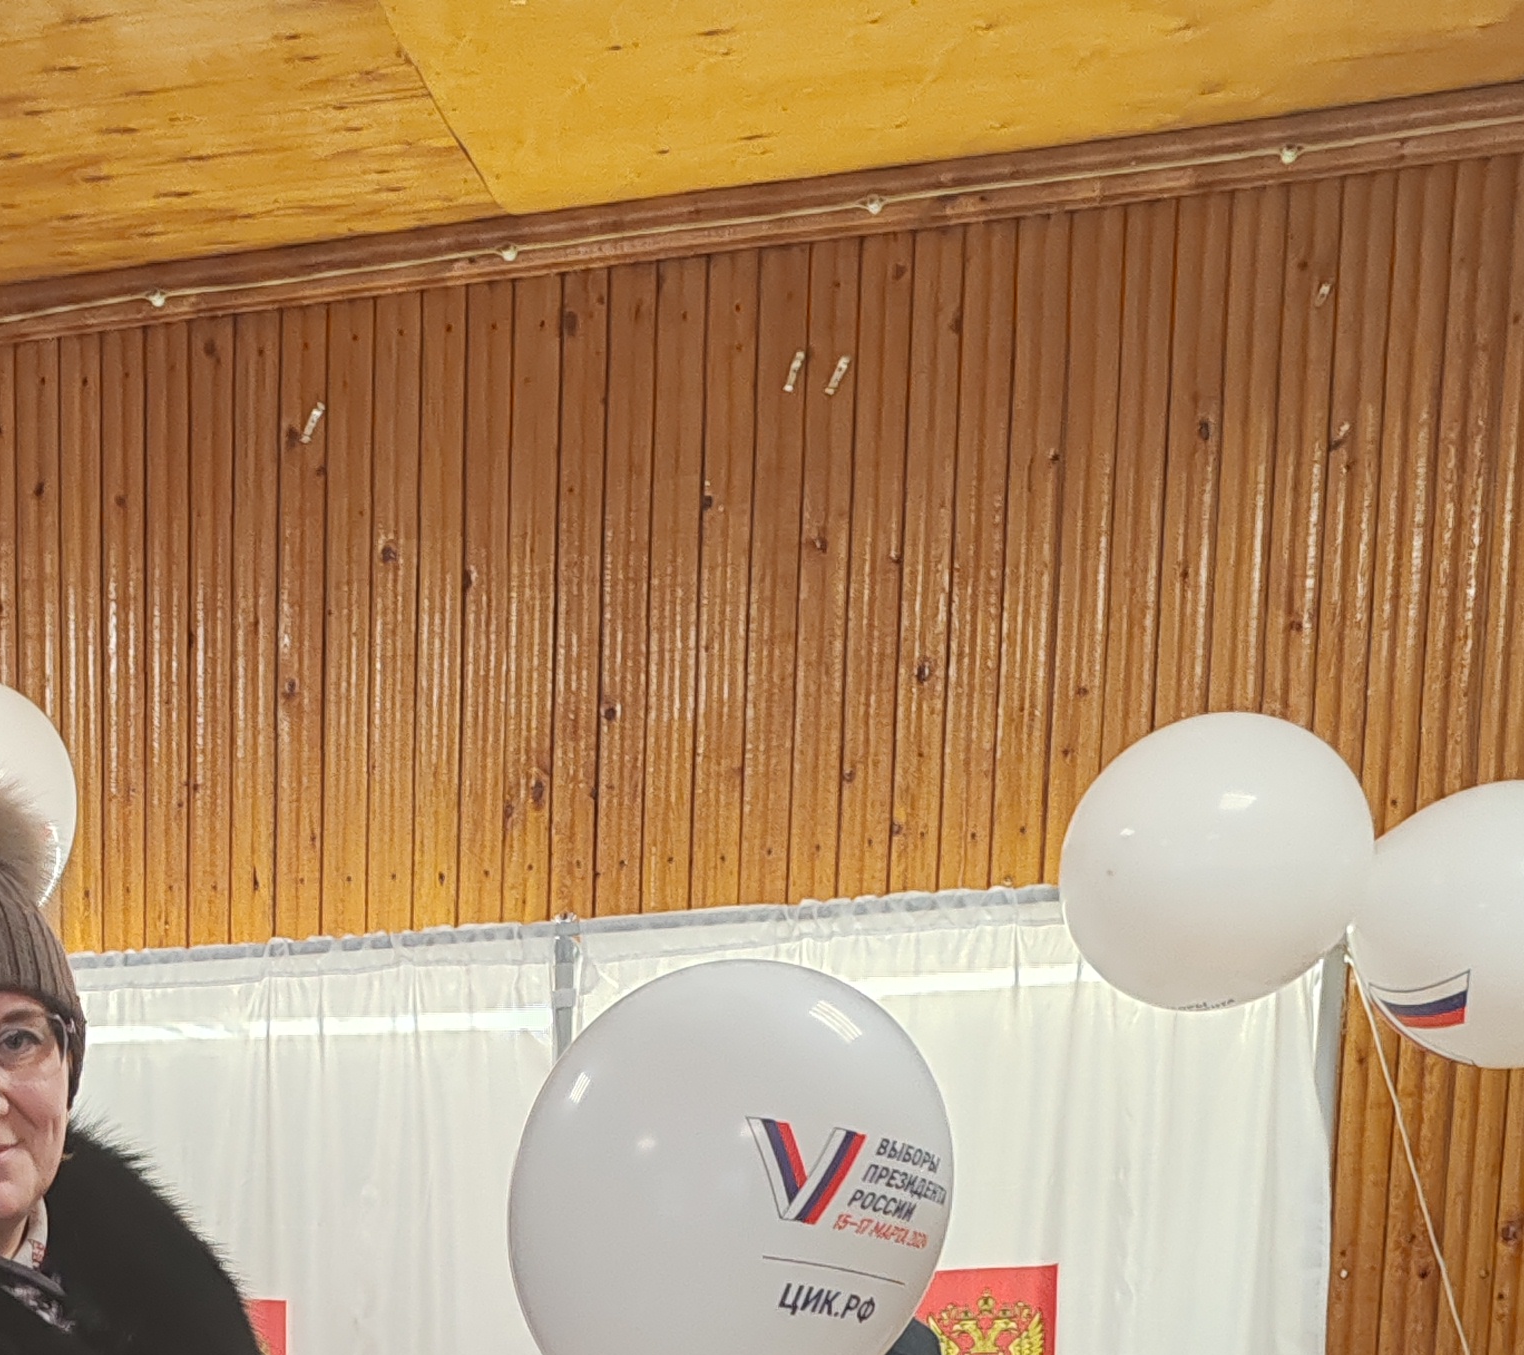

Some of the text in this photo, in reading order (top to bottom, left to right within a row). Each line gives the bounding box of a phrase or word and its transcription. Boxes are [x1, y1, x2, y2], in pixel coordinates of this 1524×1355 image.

[875, 1137, 941, 1174] ВЫБОРЫ
[847, 1188, 918, 1222] РОССИИ
[778, 1282, 876, 1324] ЦИК.РФ
